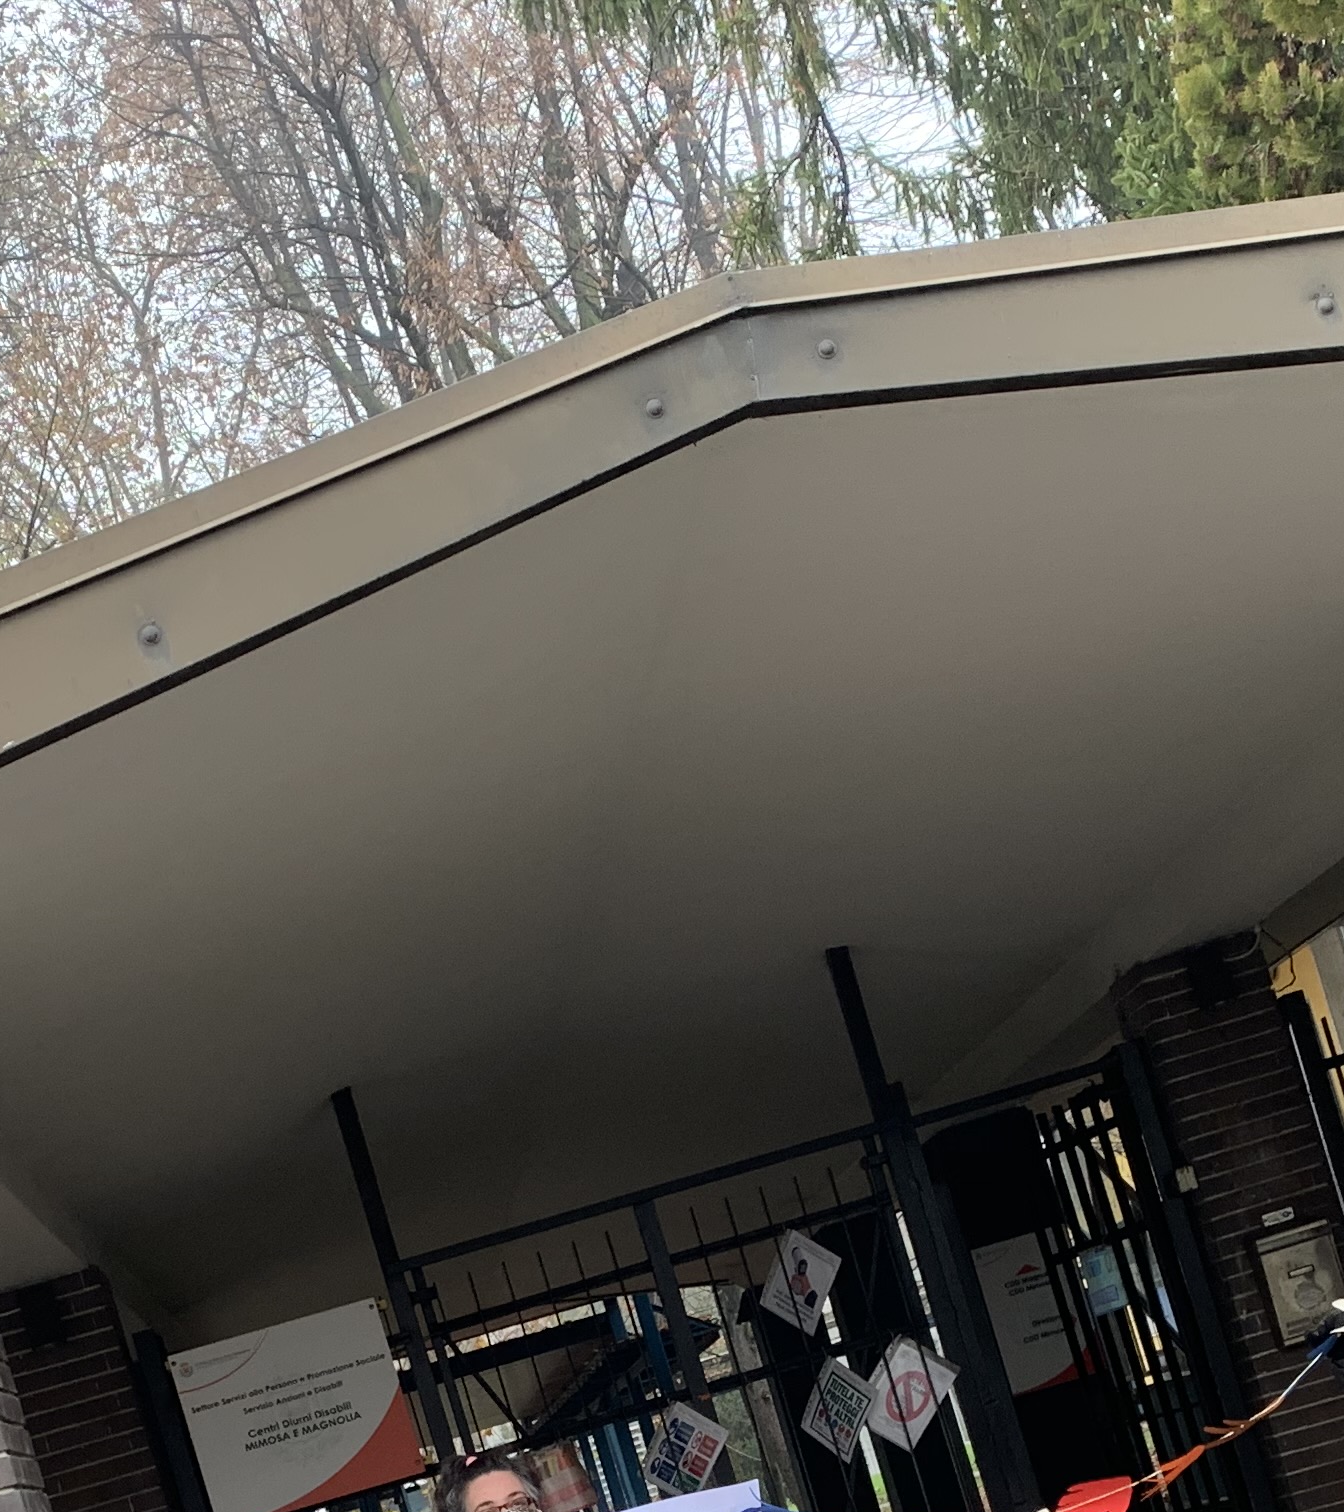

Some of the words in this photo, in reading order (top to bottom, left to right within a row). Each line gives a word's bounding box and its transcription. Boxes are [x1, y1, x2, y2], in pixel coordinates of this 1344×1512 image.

[191, 1401, 220, 1414] Settore
[221, 1391, 248, 1405] Servizi
[265, 1379, 298, 1392] Persona
[306, 1362, 354, 1380] Promozione
[355, 1353, 385, 1367] Sociale
[243, 1401, 274, 1414] Servizio
[314, 1380, 343, 1394] Disabili
[830, 1378, 855, 1403] TUTELA
[248, 1420, 280, 1438] Centri
[282, 1413, 313, 1428] Diurni
[314, 1401, 352, 1419] Disabili
[826, 1388, 860, 1419] PROTEGGI
[245, 1432, 291, 1452] MIMOSA
[292, 1429, 299, 1438] E
[302, 1411, 362, 1435] MAGNOLIA
